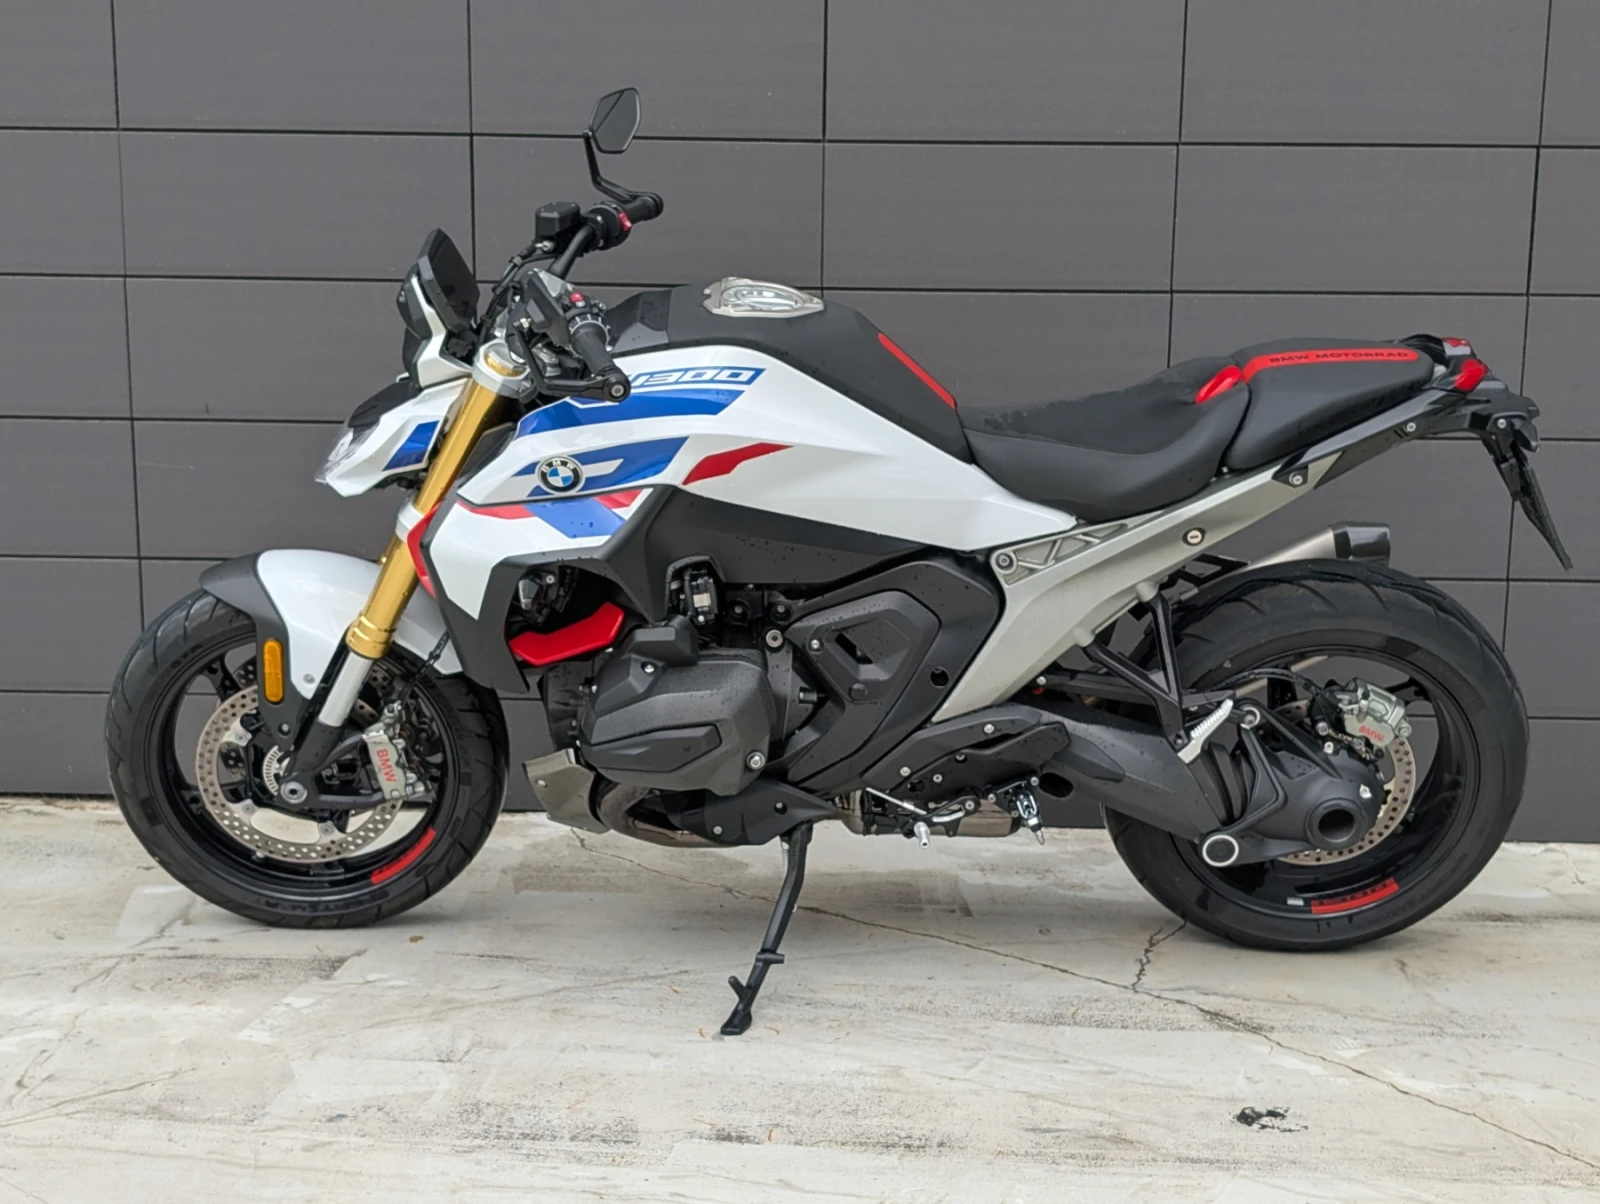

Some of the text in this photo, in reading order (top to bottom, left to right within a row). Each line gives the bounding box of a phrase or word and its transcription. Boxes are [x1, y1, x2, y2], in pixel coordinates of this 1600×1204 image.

[1269, 355, 1309, 363] BMW
[540, 459, 576, 473] BMW
[1358, 725, 1385, 742] BMW
[376, 749, 398, 783] BMW
